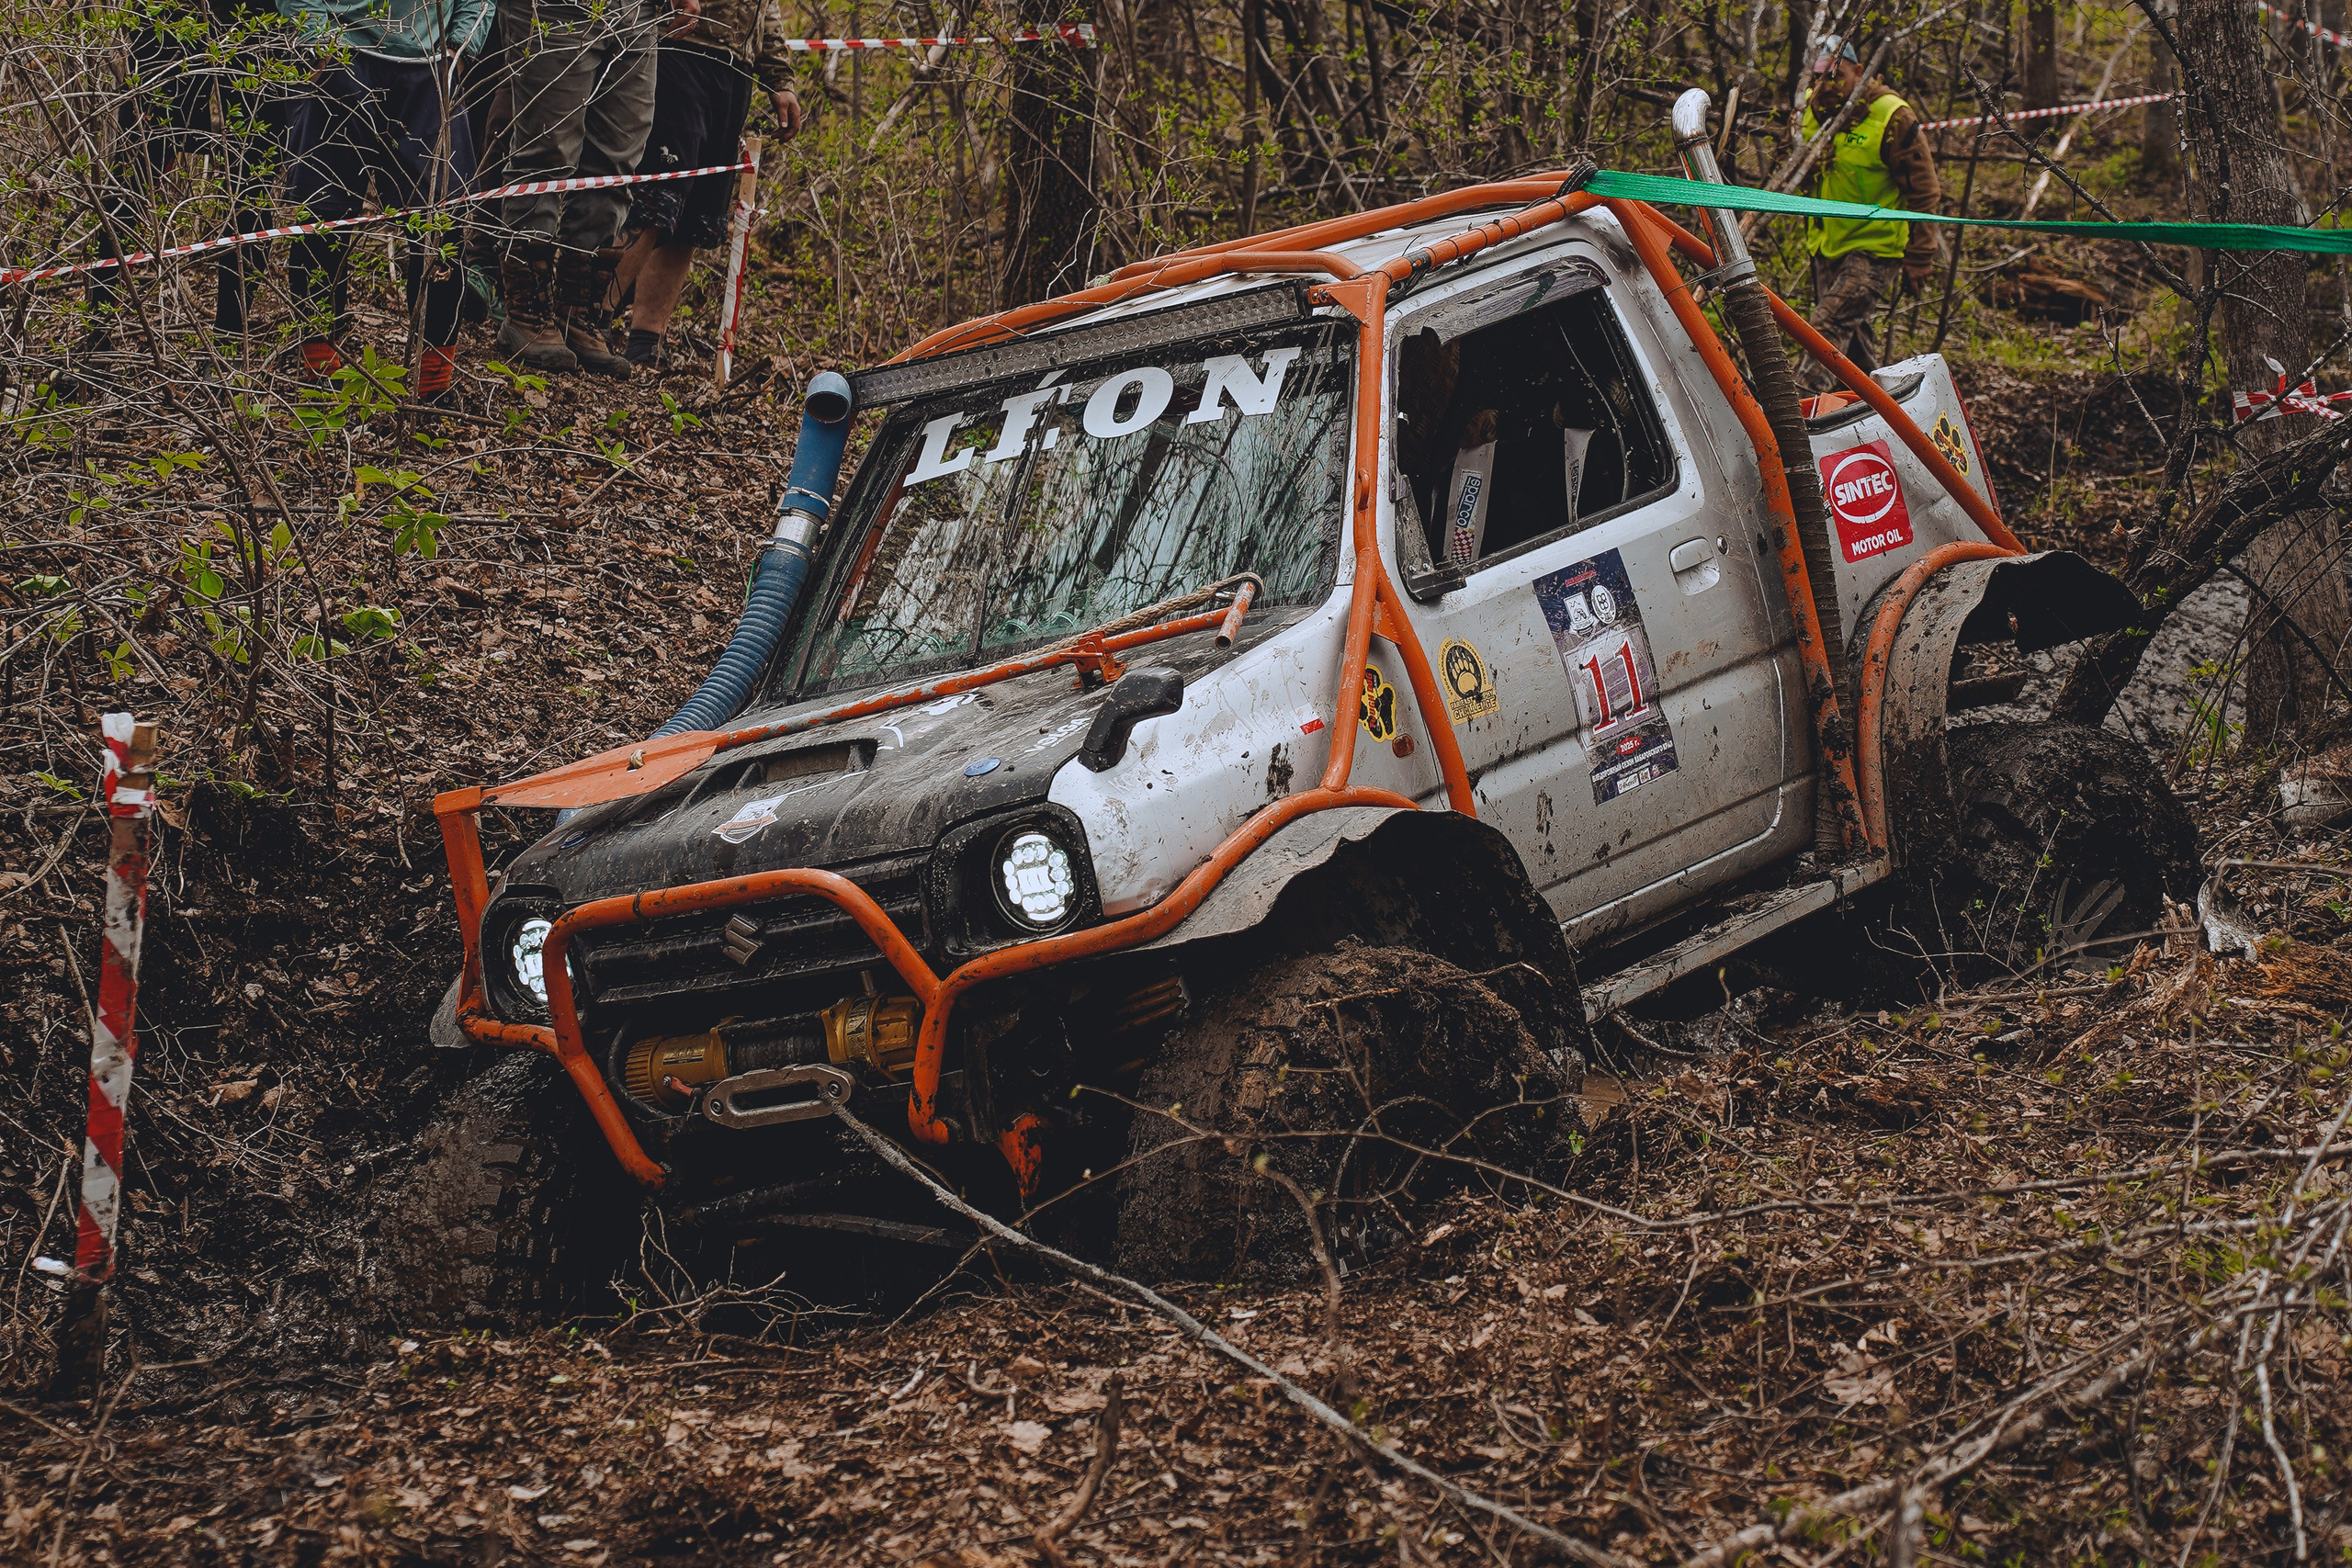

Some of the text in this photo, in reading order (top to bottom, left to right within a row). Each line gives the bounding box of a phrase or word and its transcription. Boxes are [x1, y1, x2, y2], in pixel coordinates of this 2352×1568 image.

[902, 346, 1302, 487] LÉON
[1456, 477, 1481, 526] sparco
[1834, 470, 1894, 506] SINTEC
[1851, 529, 1904, 556] MOTOR OIL
[1581, 640, 1650, 735] 11
[1368, 694, 1376, 728] TOUGH
[1453, 699, 1497, 719] CHALLENGE
[1024, 717, 1091, 752] VOLGA
[1620, 740, 1634, 752] 2025
